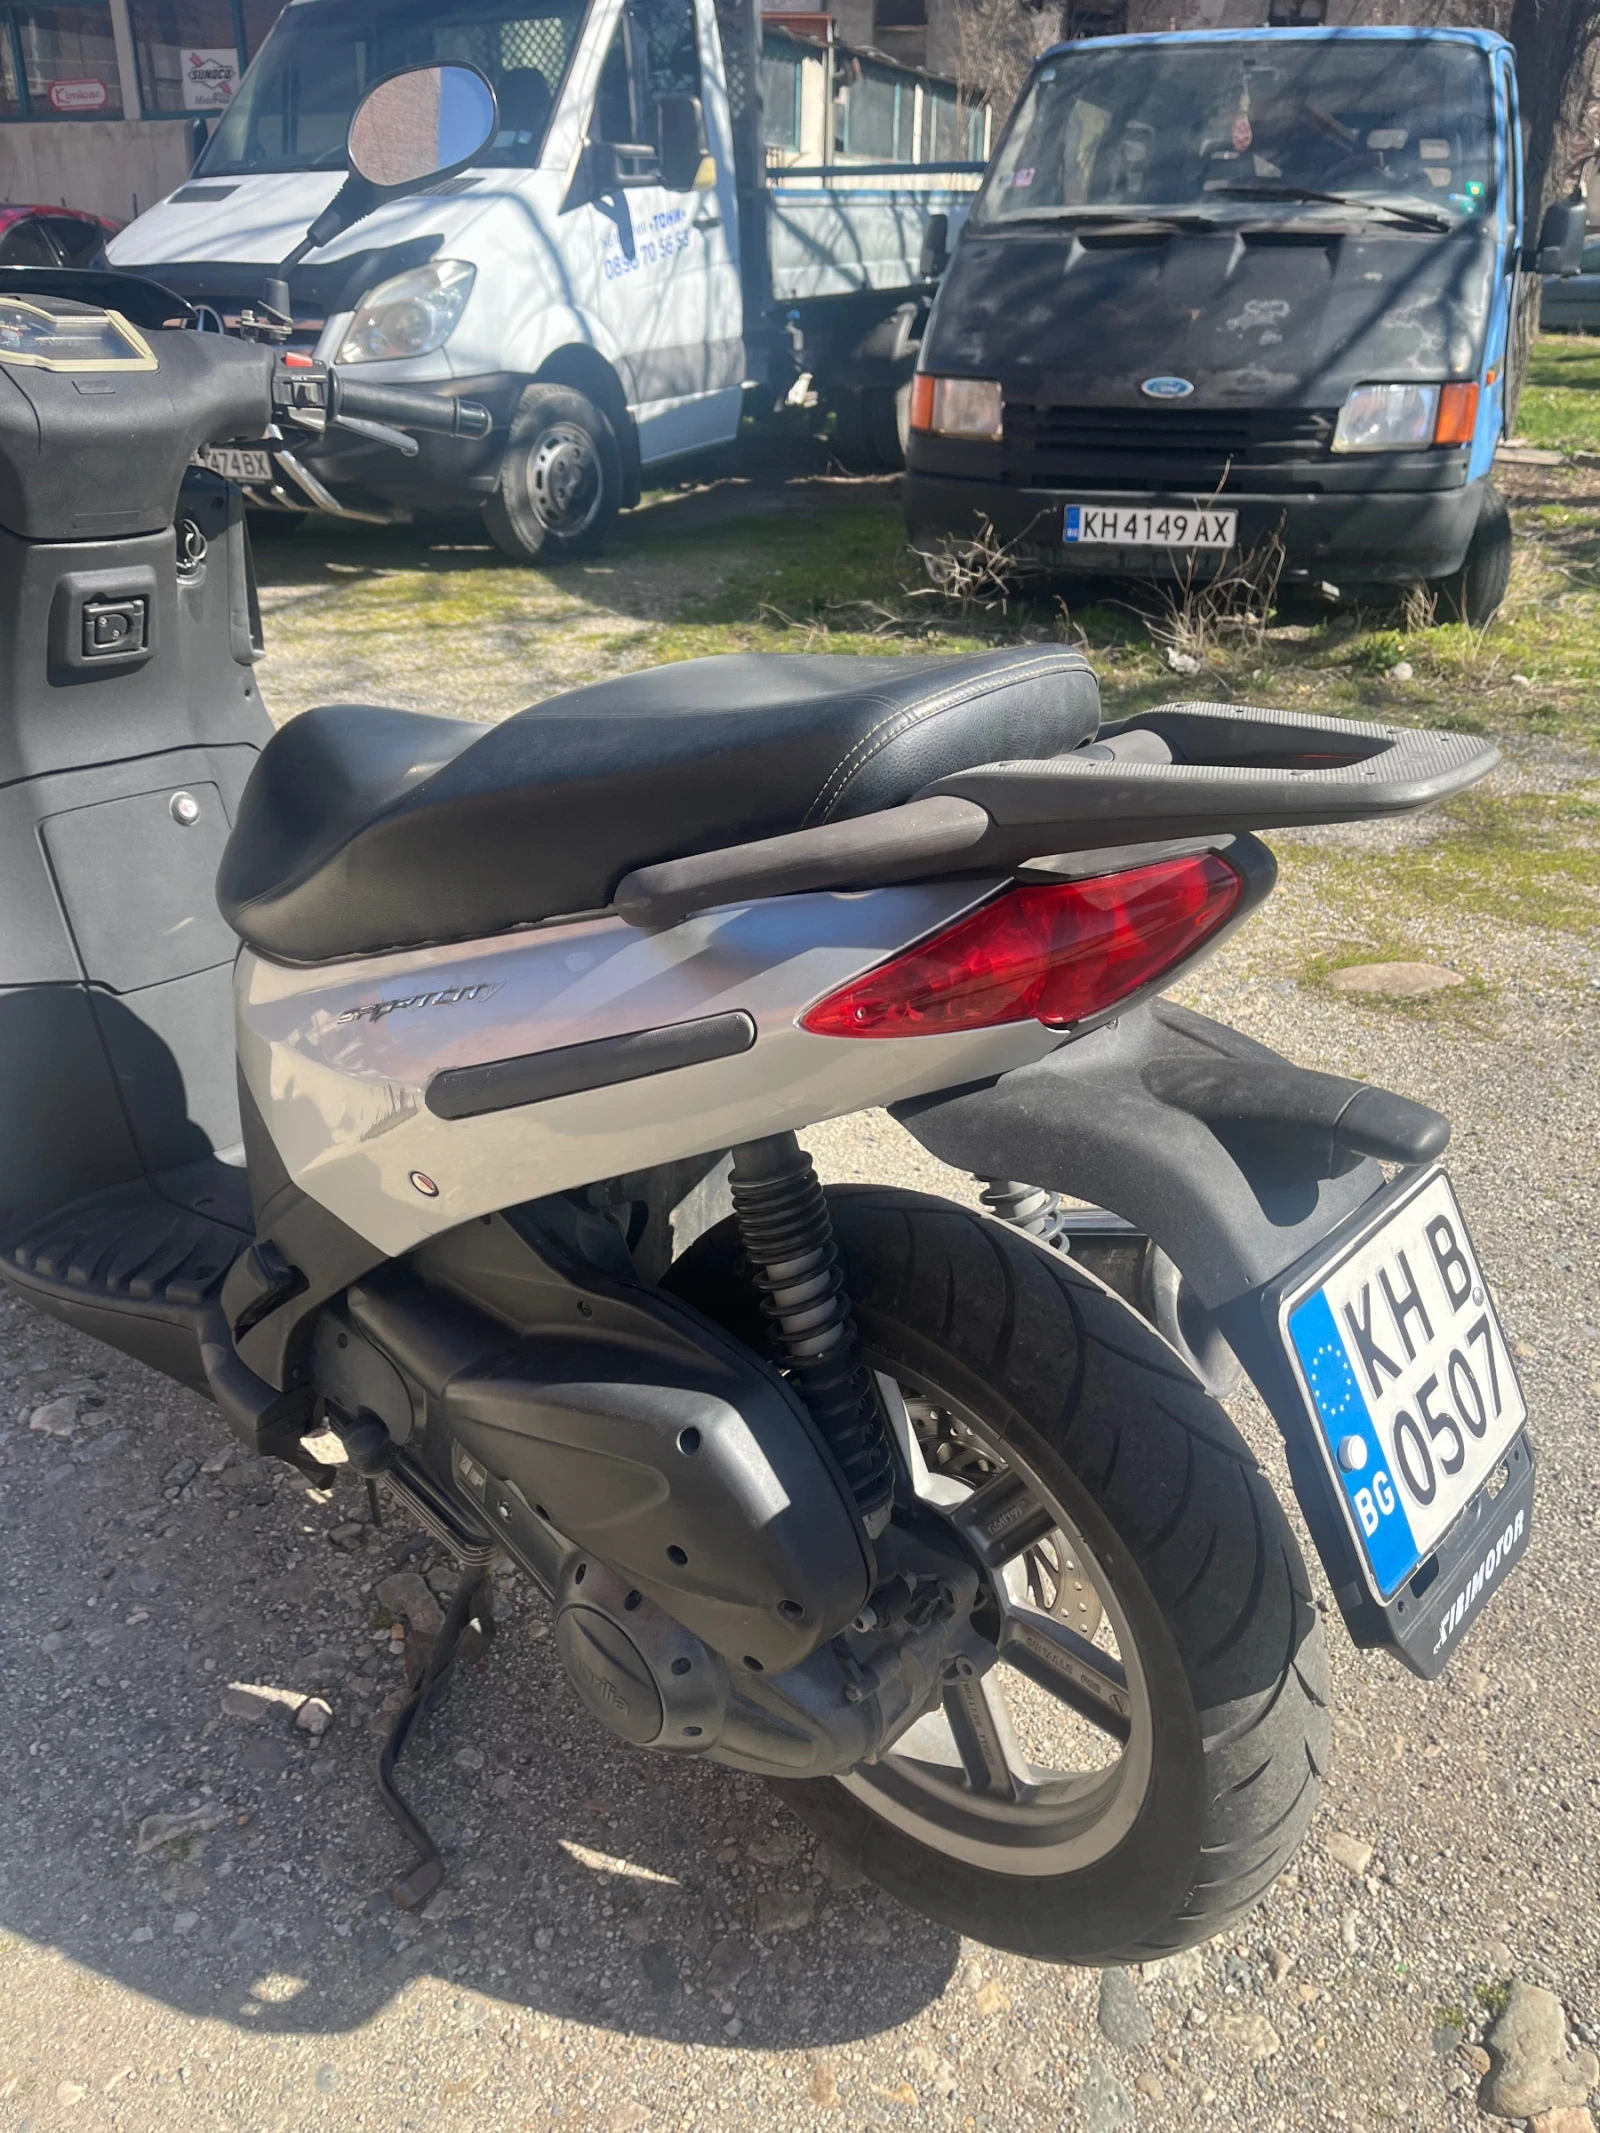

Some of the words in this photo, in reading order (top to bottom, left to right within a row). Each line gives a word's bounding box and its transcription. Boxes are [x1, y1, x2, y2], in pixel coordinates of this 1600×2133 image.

[190, 69, 233, 80] SUNOCO
[1393, 1311, 1502, 1507] 0507
[1353, 1470, 1396, 1538] BG
